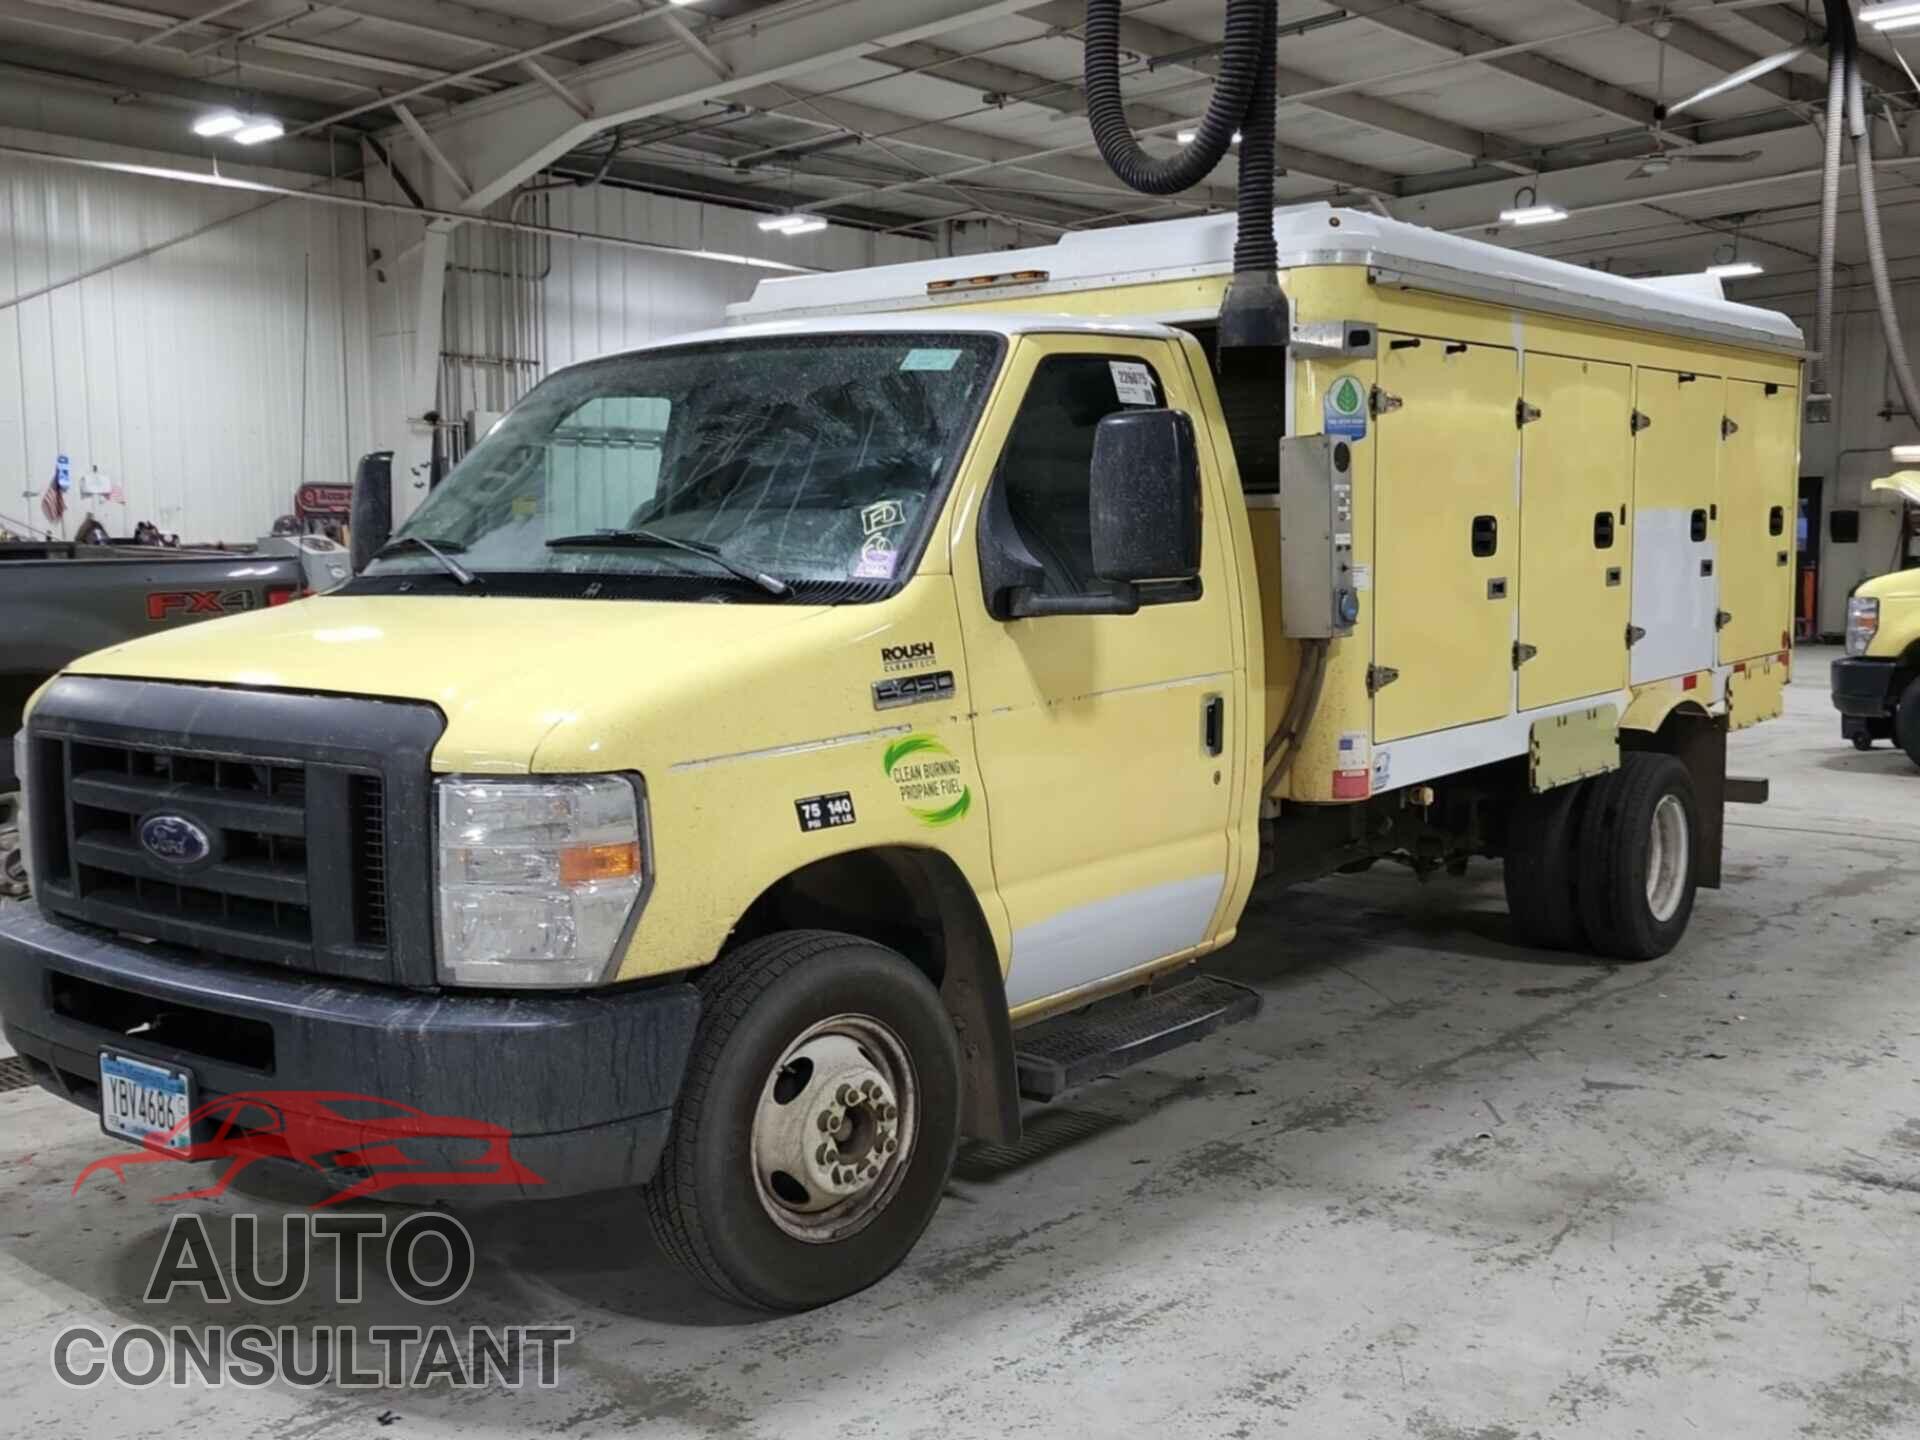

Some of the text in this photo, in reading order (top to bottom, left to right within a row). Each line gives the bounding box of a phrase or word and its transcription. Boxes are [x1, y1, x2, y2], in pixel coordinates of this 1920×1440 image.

[146, 591, 254, 620] FX4
[881, 641, 935, 662] ROUSH
[893, 759, 961, 783] CLEAN BURNING
[899, 778, 963, 802] PROPANE FUEL
[801, 803, 822, 819] 75
[826, 798, 852, 815] 140
